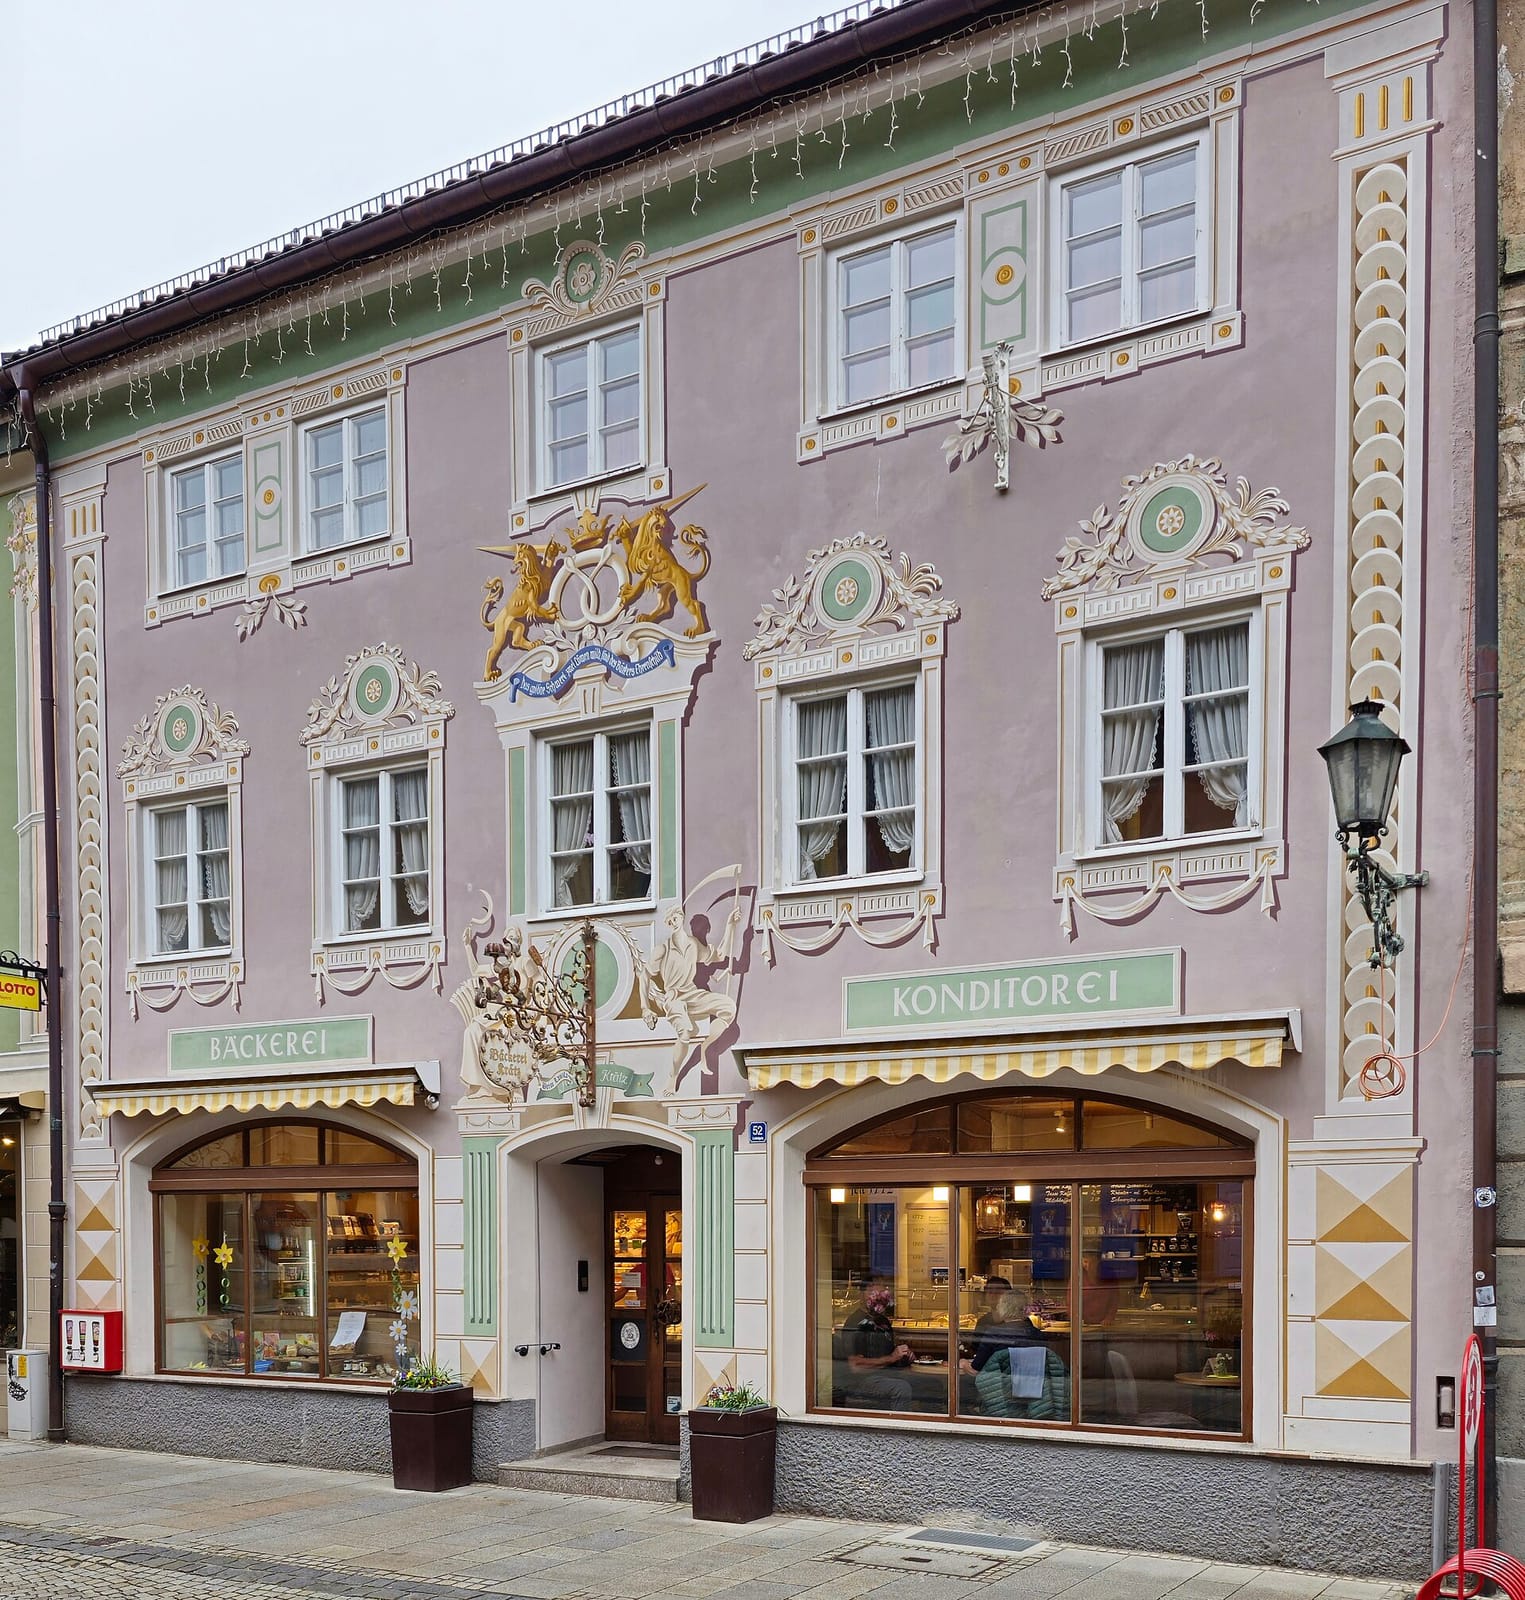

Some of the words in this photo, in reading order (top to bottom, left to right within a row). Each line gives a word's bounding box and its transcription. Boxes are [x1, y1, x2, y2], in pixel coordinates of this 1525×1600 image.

[0, 982, 36, 996] LOTTO
[893, 970, 1118, 1016] KONDITOREI
[210, 1029, 326, 1060] BÄCKEREI
[489, 1048, 528, 1065] Bäckerei
[752, 1125, 763, 1135] 52
